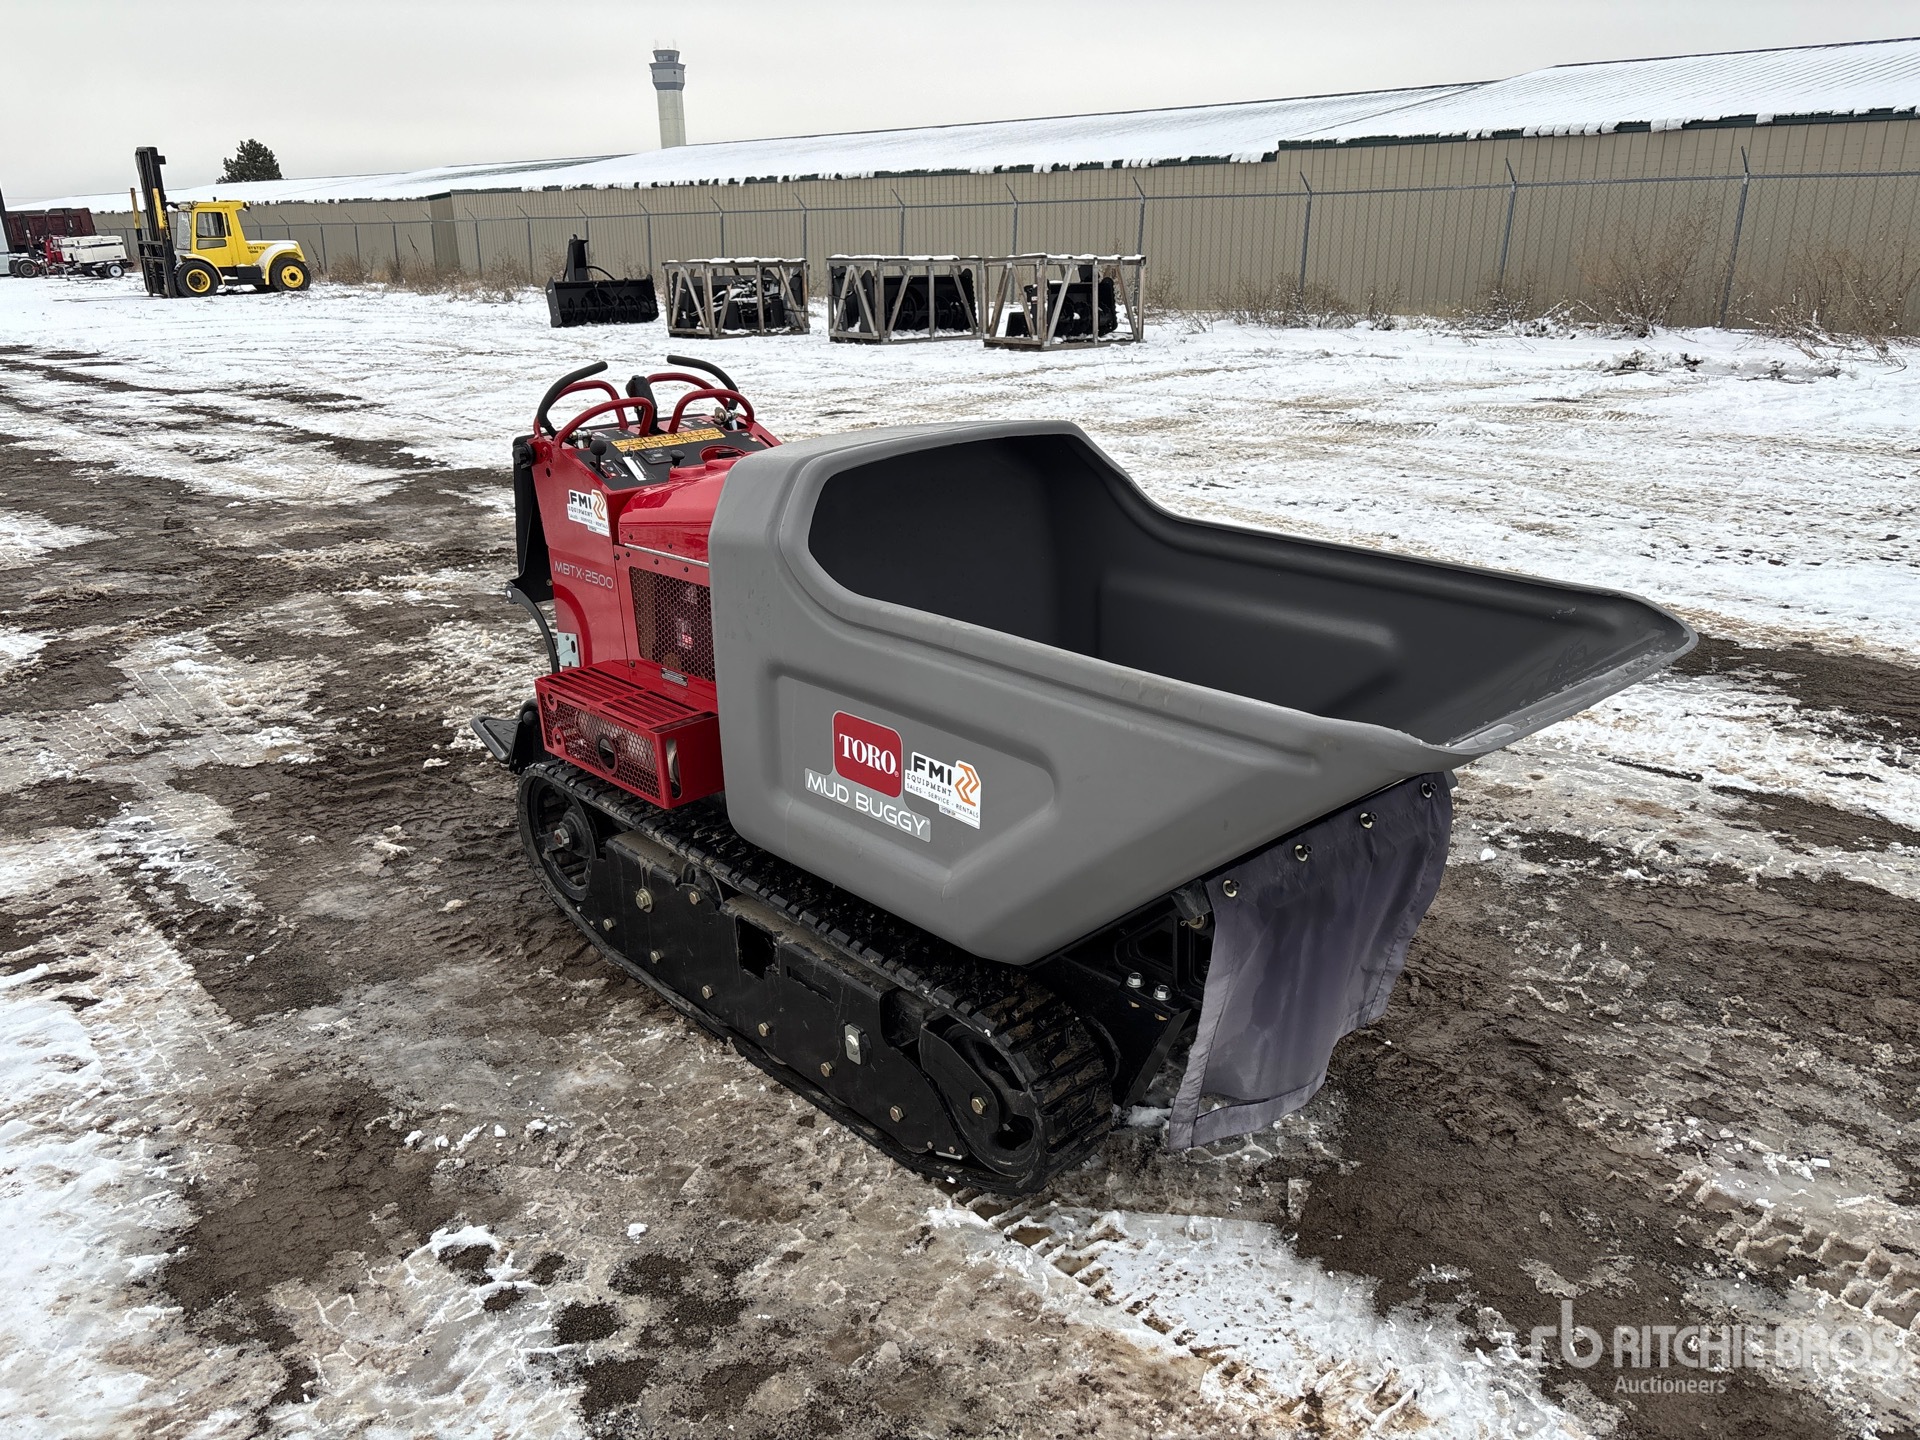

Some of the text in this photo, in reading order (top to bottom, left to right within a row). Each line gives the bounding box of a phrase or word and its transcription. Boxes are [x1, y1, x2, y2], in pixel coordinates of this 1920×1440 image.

[570, 491, 592, 510] FMI
[839, 733, 897, 775] TORO
[913, 755, 952, 786] FMI
[906, 772, 952, 797] EQUIPMENT
[906, 782, 922, 794] SALES
[927, 791, 950, 806] SERVICE
[955, 803, 979, 819] RENTALS
[807, 772, 926, 836] MUD BUGGY
